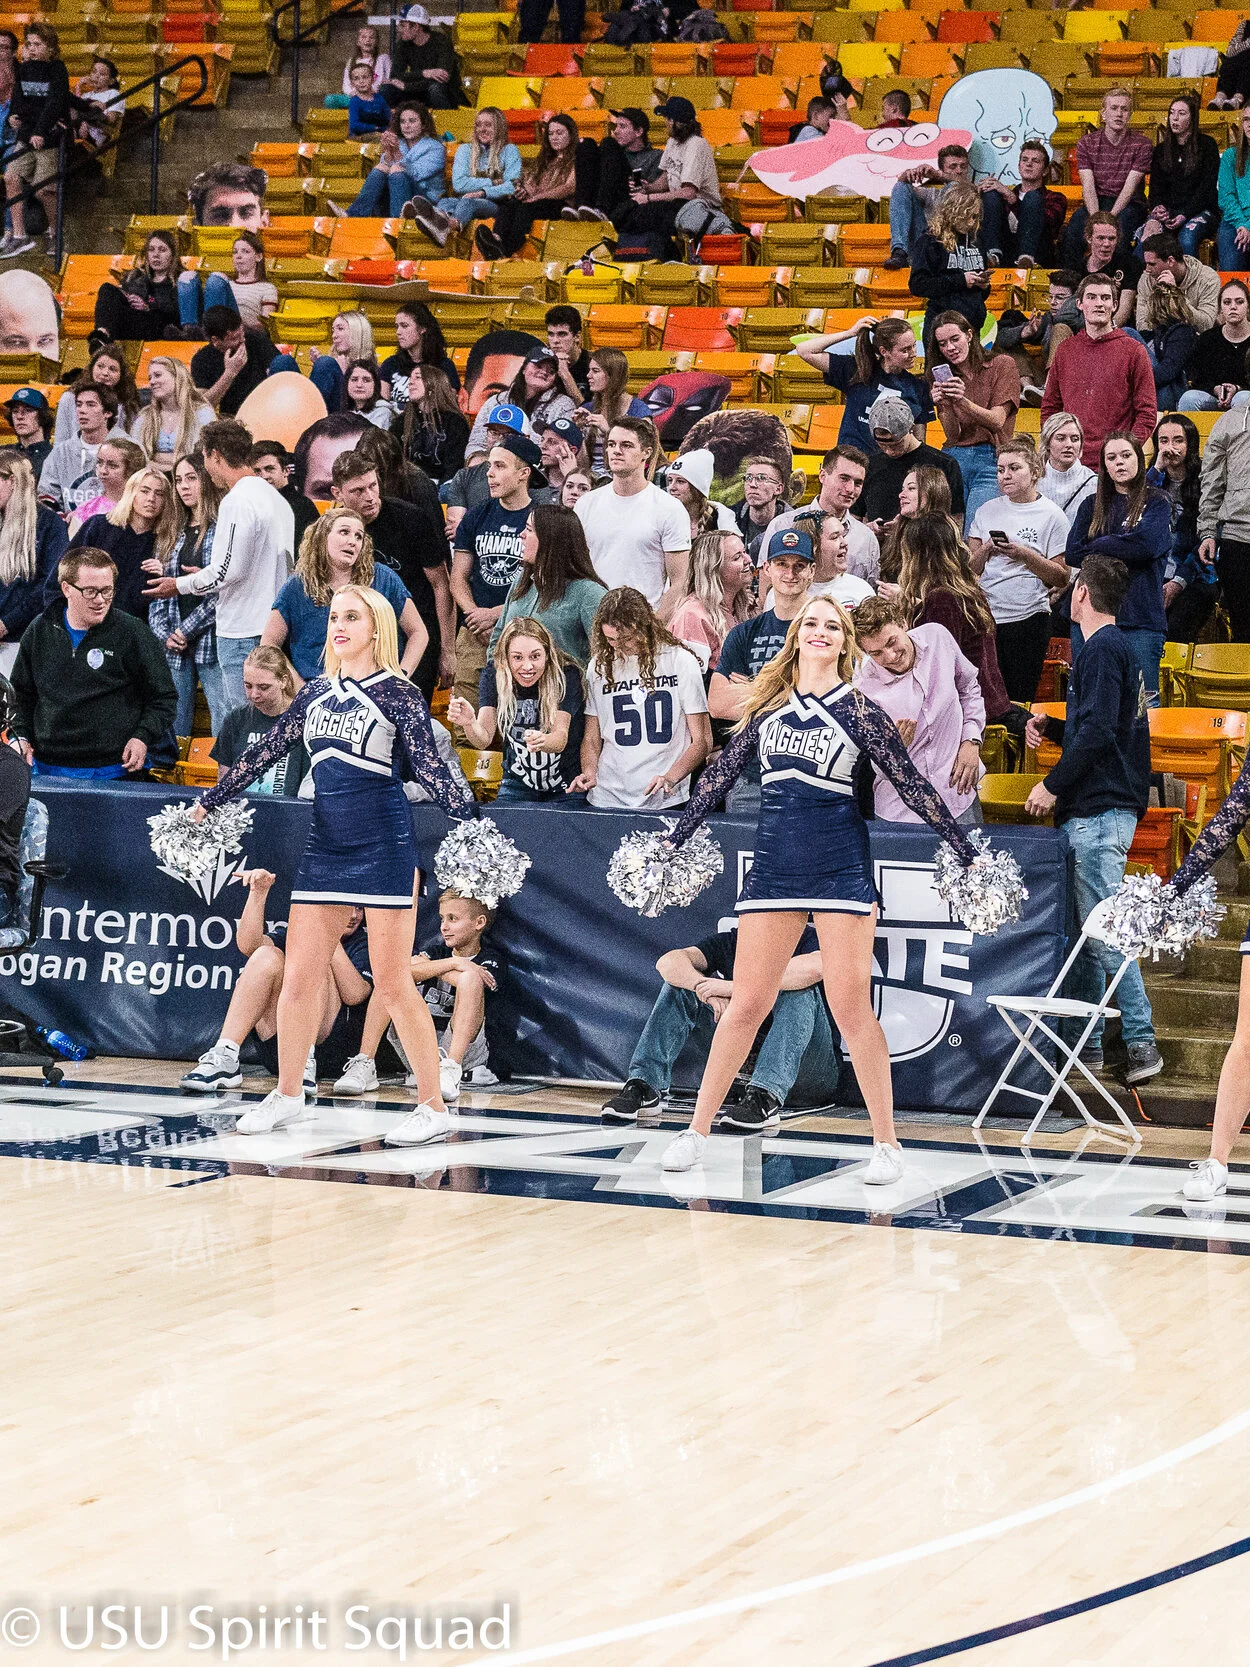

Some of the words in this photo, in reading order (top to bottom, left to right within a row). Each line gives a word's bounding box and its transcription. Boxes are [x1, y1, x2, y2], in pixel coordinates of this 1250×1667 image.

[784, 410, 793, 418] 12
[475, 534, 524, 557] CHAMPIO
[306, 704, 370, 745] AGGIES
[613, 690, 673, 746] 50
[1213, 717, 1223, 728] 19
[762, 719, 835, 764] AGGIES
[272, 757, 288, 796] RONTIER
[481, 760, 490, 769] 13
[41, 899, 289, 951] ntermo
[0, 950, 87, 986] ogan
[100, 950, 243, 996] Region
